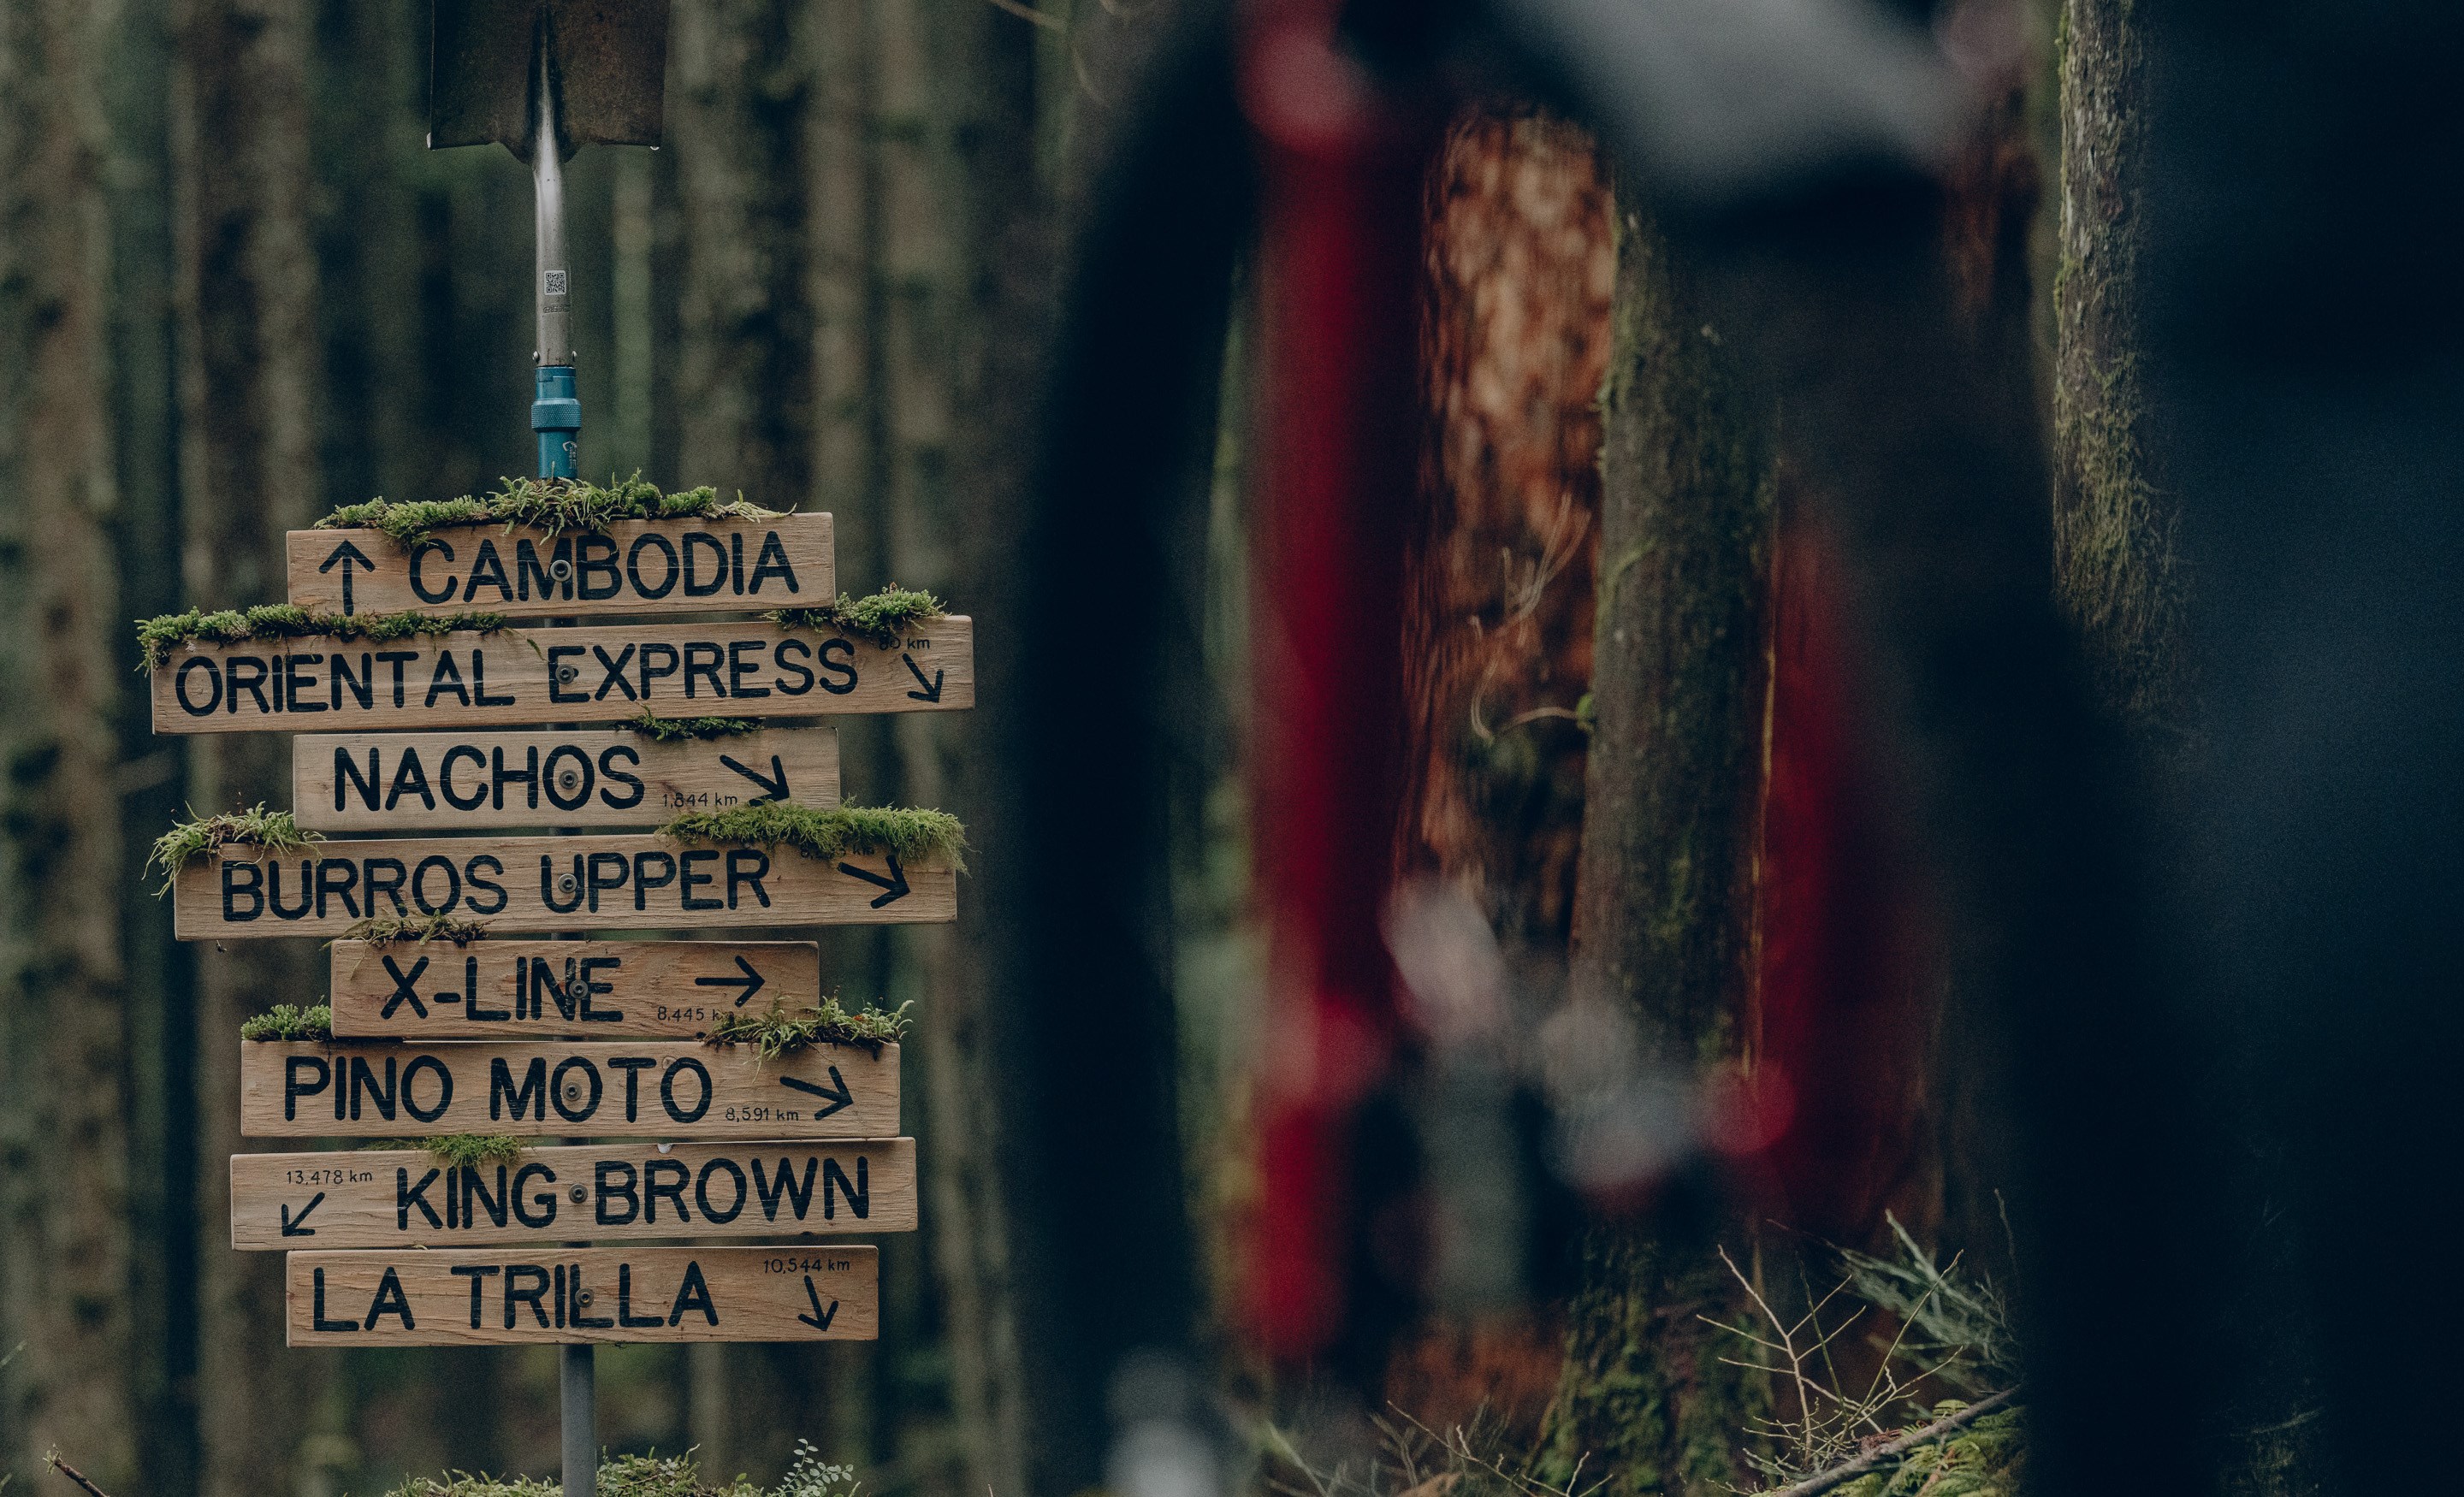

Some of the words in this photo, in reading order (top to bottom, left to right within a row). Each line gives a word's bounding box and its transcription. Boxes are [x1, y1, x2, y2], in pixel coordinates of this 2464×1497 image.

[408, 530, 800, 605] CAMBODIA
[175, 648, 516, 717] ORIENTAL
[548, 637, 858, 704] EXPRESS
[907, 636, 930, 650] km
[334, 744, 645, 812] NACHOS
[662, 792, 708, 809] 1,844
[714, 792, 738, 807] km
[222, 855, 508, 922] BURROS
[540, 849, 771, 914] UPPER
[380, 955, 624, 1022] X-LINE
[284, 1054, 453, 1123] PINO
[489, 1056, 713, 1124] MOTO
[725, 1107, 769, 1122] 8,591
[776, 1109, 799, 1121] km
[349, 1169, 373, 1183] km
[396, 1161, 557, 1230] KING
[595, 1156, 869, 1226] BROWN
[313, 1266, 416, 1332] LA
[450, 1260, 720, 1330] TRILLA
[763, 1257, 822, 1275] 10,544
[827, 1257, 850, 1272] km
